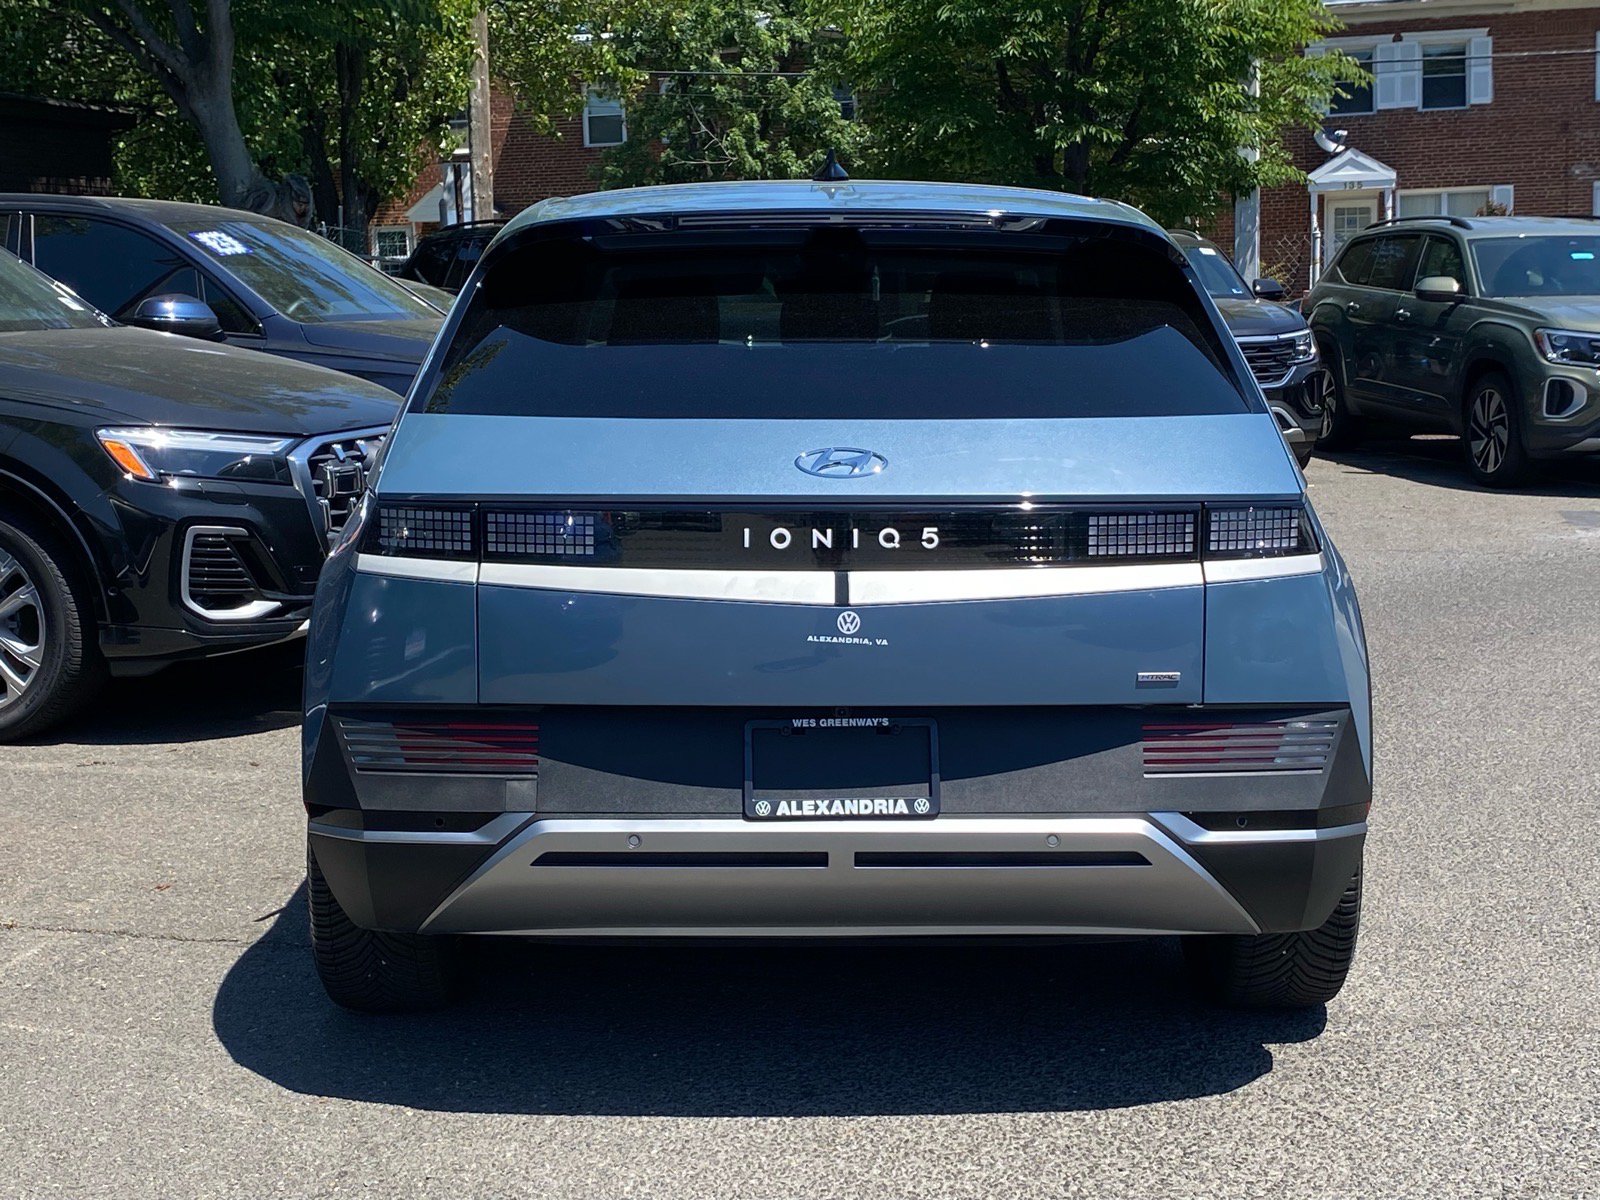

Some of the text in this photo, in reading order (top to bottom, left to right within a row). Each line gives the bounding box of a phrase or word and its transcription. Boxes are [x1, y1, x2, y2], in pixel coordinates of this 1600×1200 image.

[743, 527, 940, 550] IONIQ 5
[806, 635, 889, 646] ALEXANDRIA, VA
[792, 717, 889, 727] WES GREENWAY'S
[776, 799, 909, 816] ALEXANDRIA
